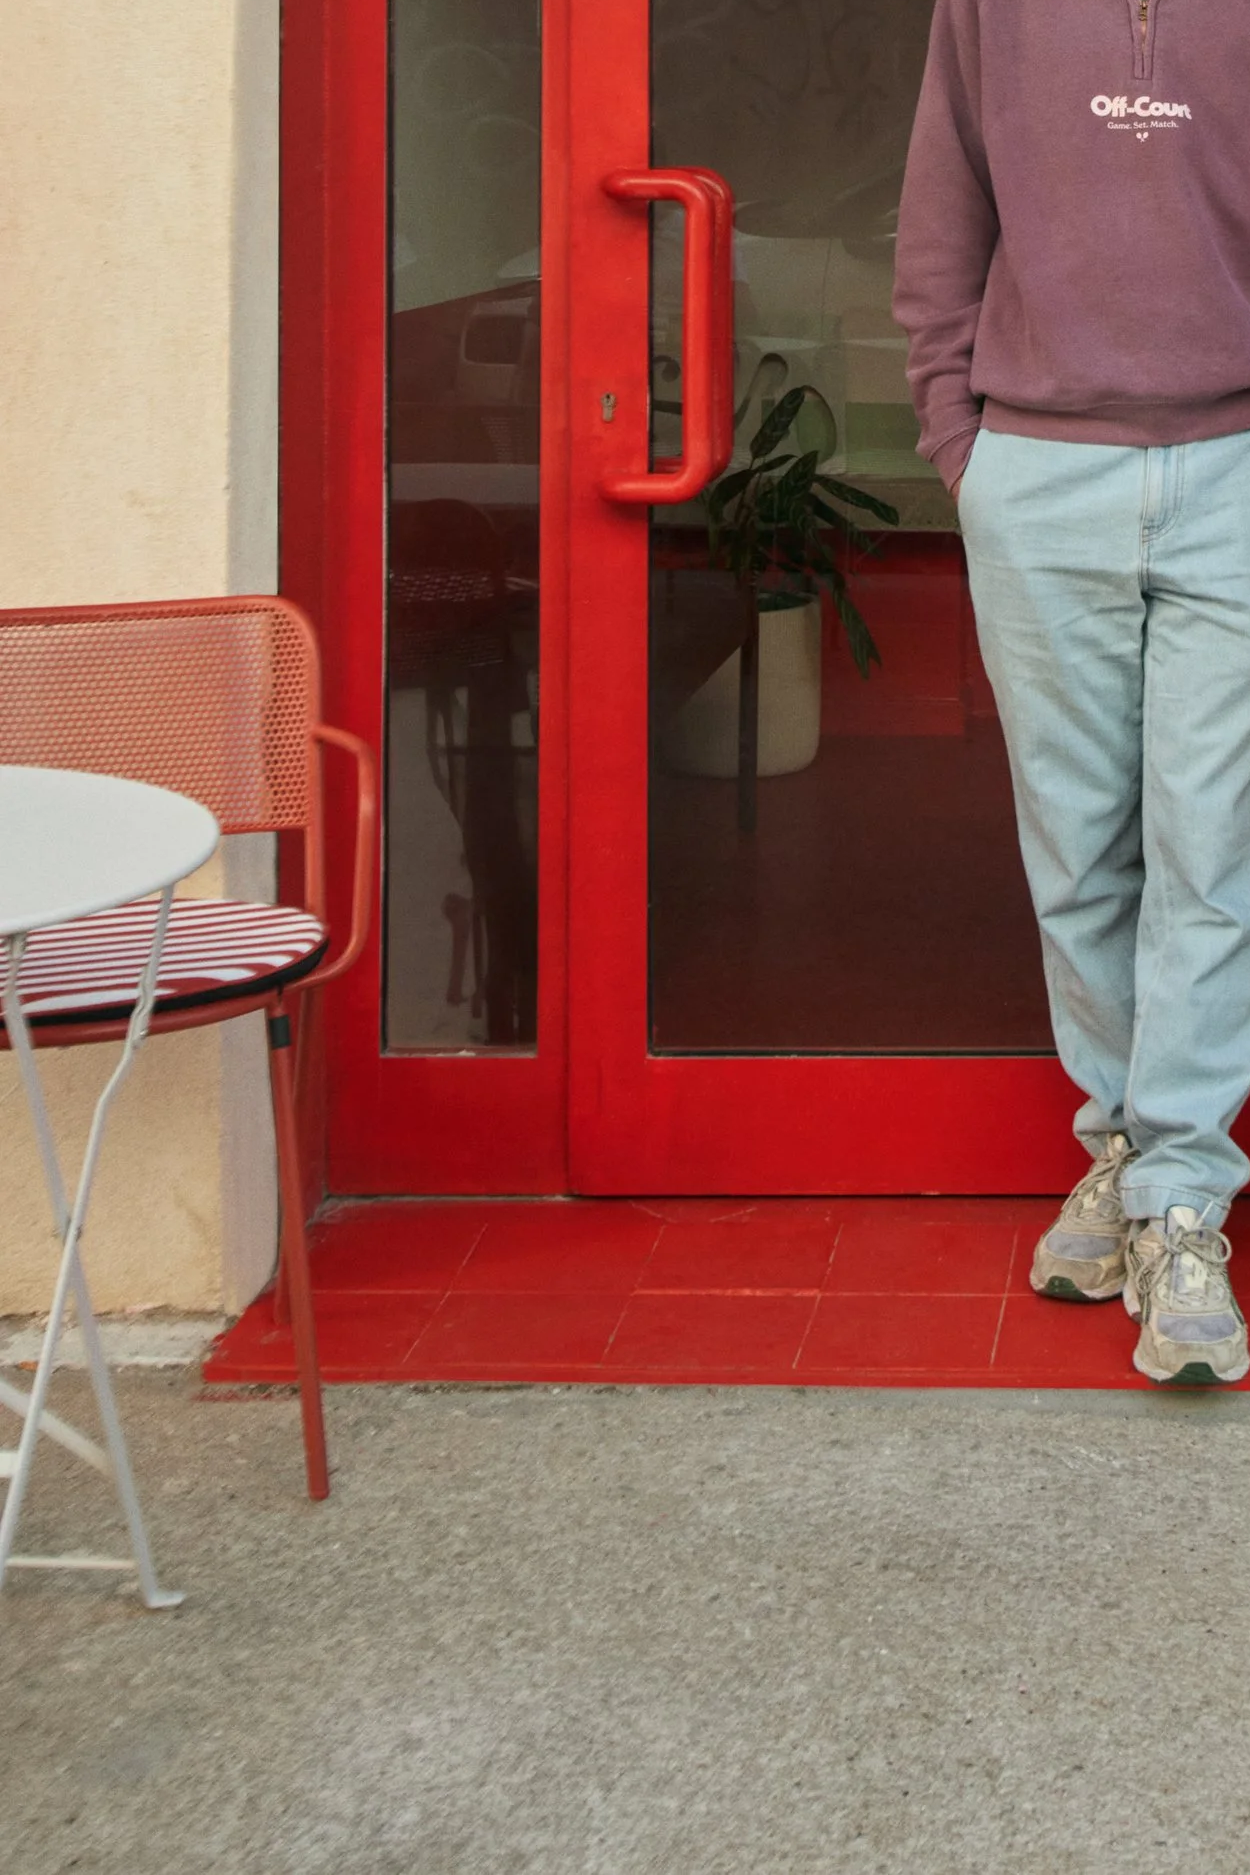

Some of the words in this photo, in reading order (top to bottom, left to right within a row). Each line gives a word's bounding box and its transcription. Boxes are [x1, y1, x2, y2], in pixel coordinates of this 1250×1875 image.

[1107, 121, 1132, 130] Game.
[1133, 121, 1148, 129] Set.
[1150, 120, 1179, 128] Match.
